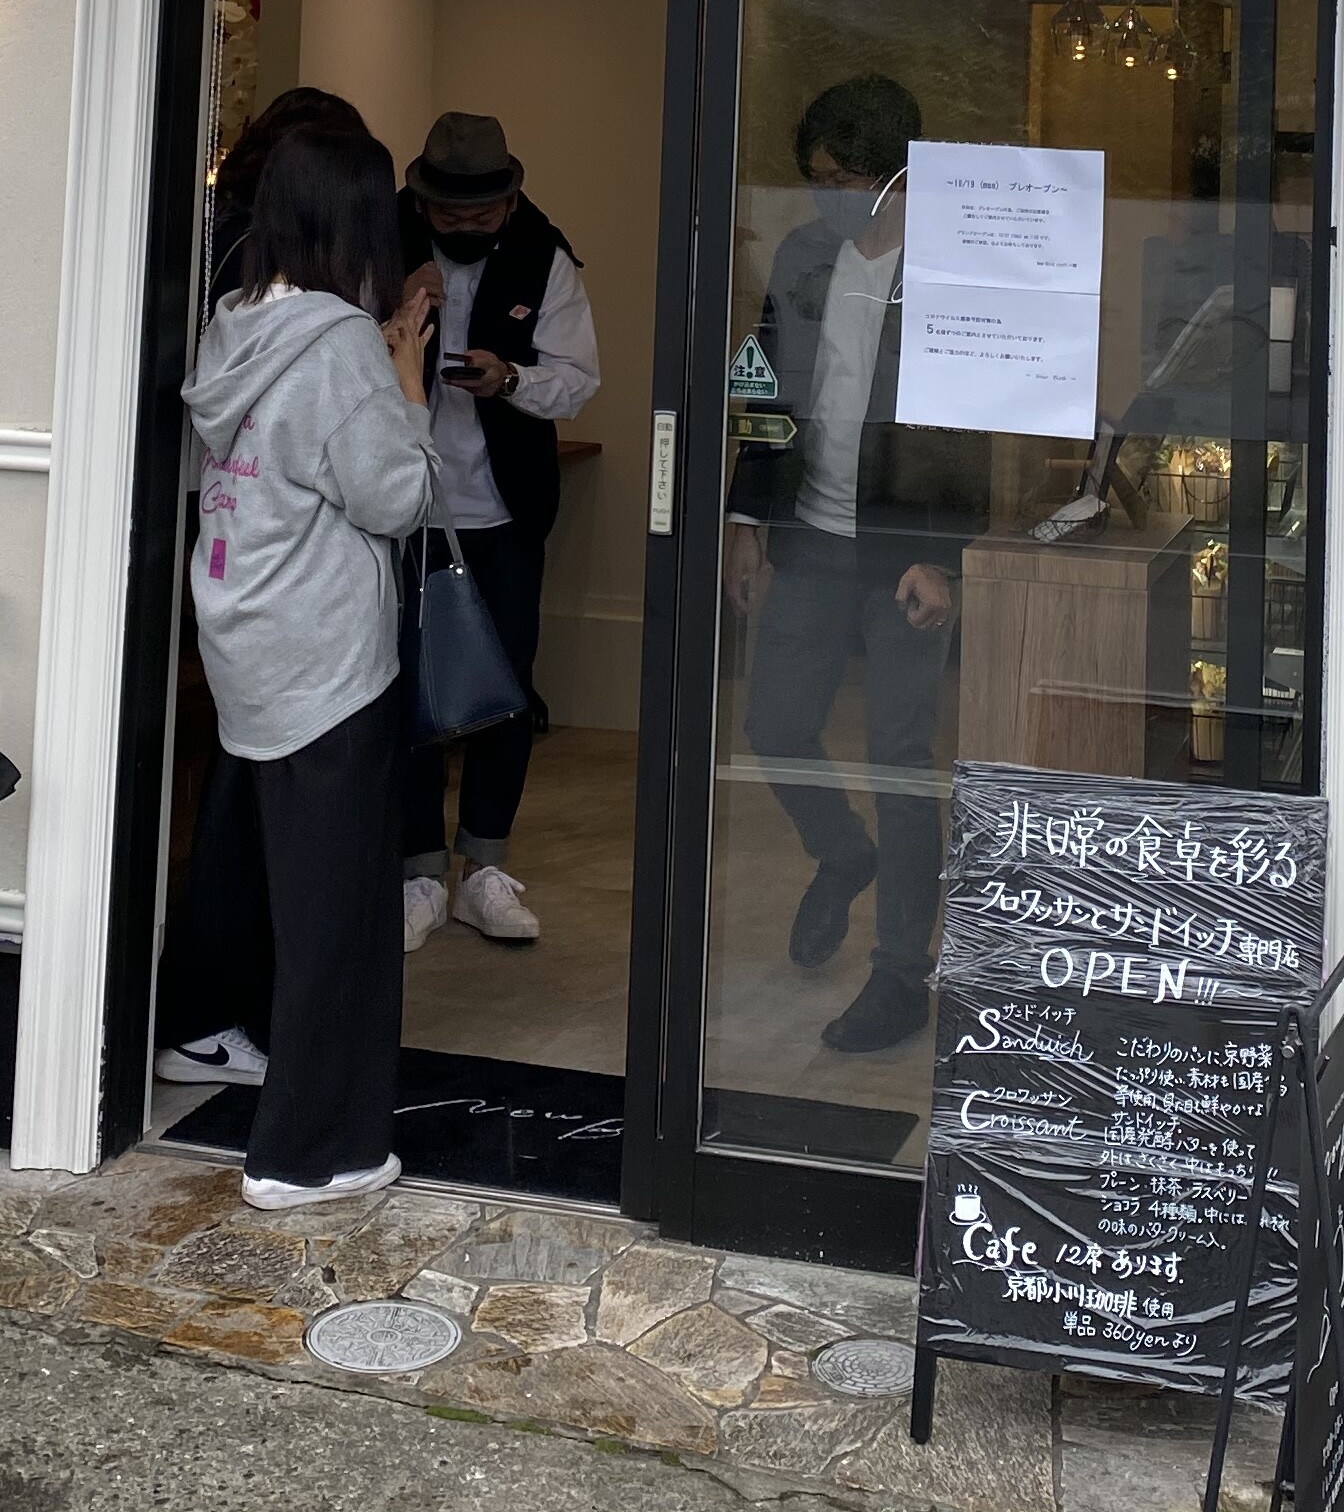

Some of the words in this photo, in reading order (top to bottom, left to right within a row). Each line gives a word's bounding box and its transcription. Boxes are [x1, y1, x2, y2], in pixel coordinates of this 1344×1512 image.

[657, 437, 670, 501] 押して下さい
[993, 799, 1298, 889] 非日常の食卓を彩る
[957, 1007, 1095, 1063] Sandwich
[1001, 1002, 1078, 1027] サンドイッチ
[960, 1088, 1092, 1142] Croissant
[990, 1085, 1074, 1108] クロワッサン
[962, 1223, 1039, 1268] Cafe
